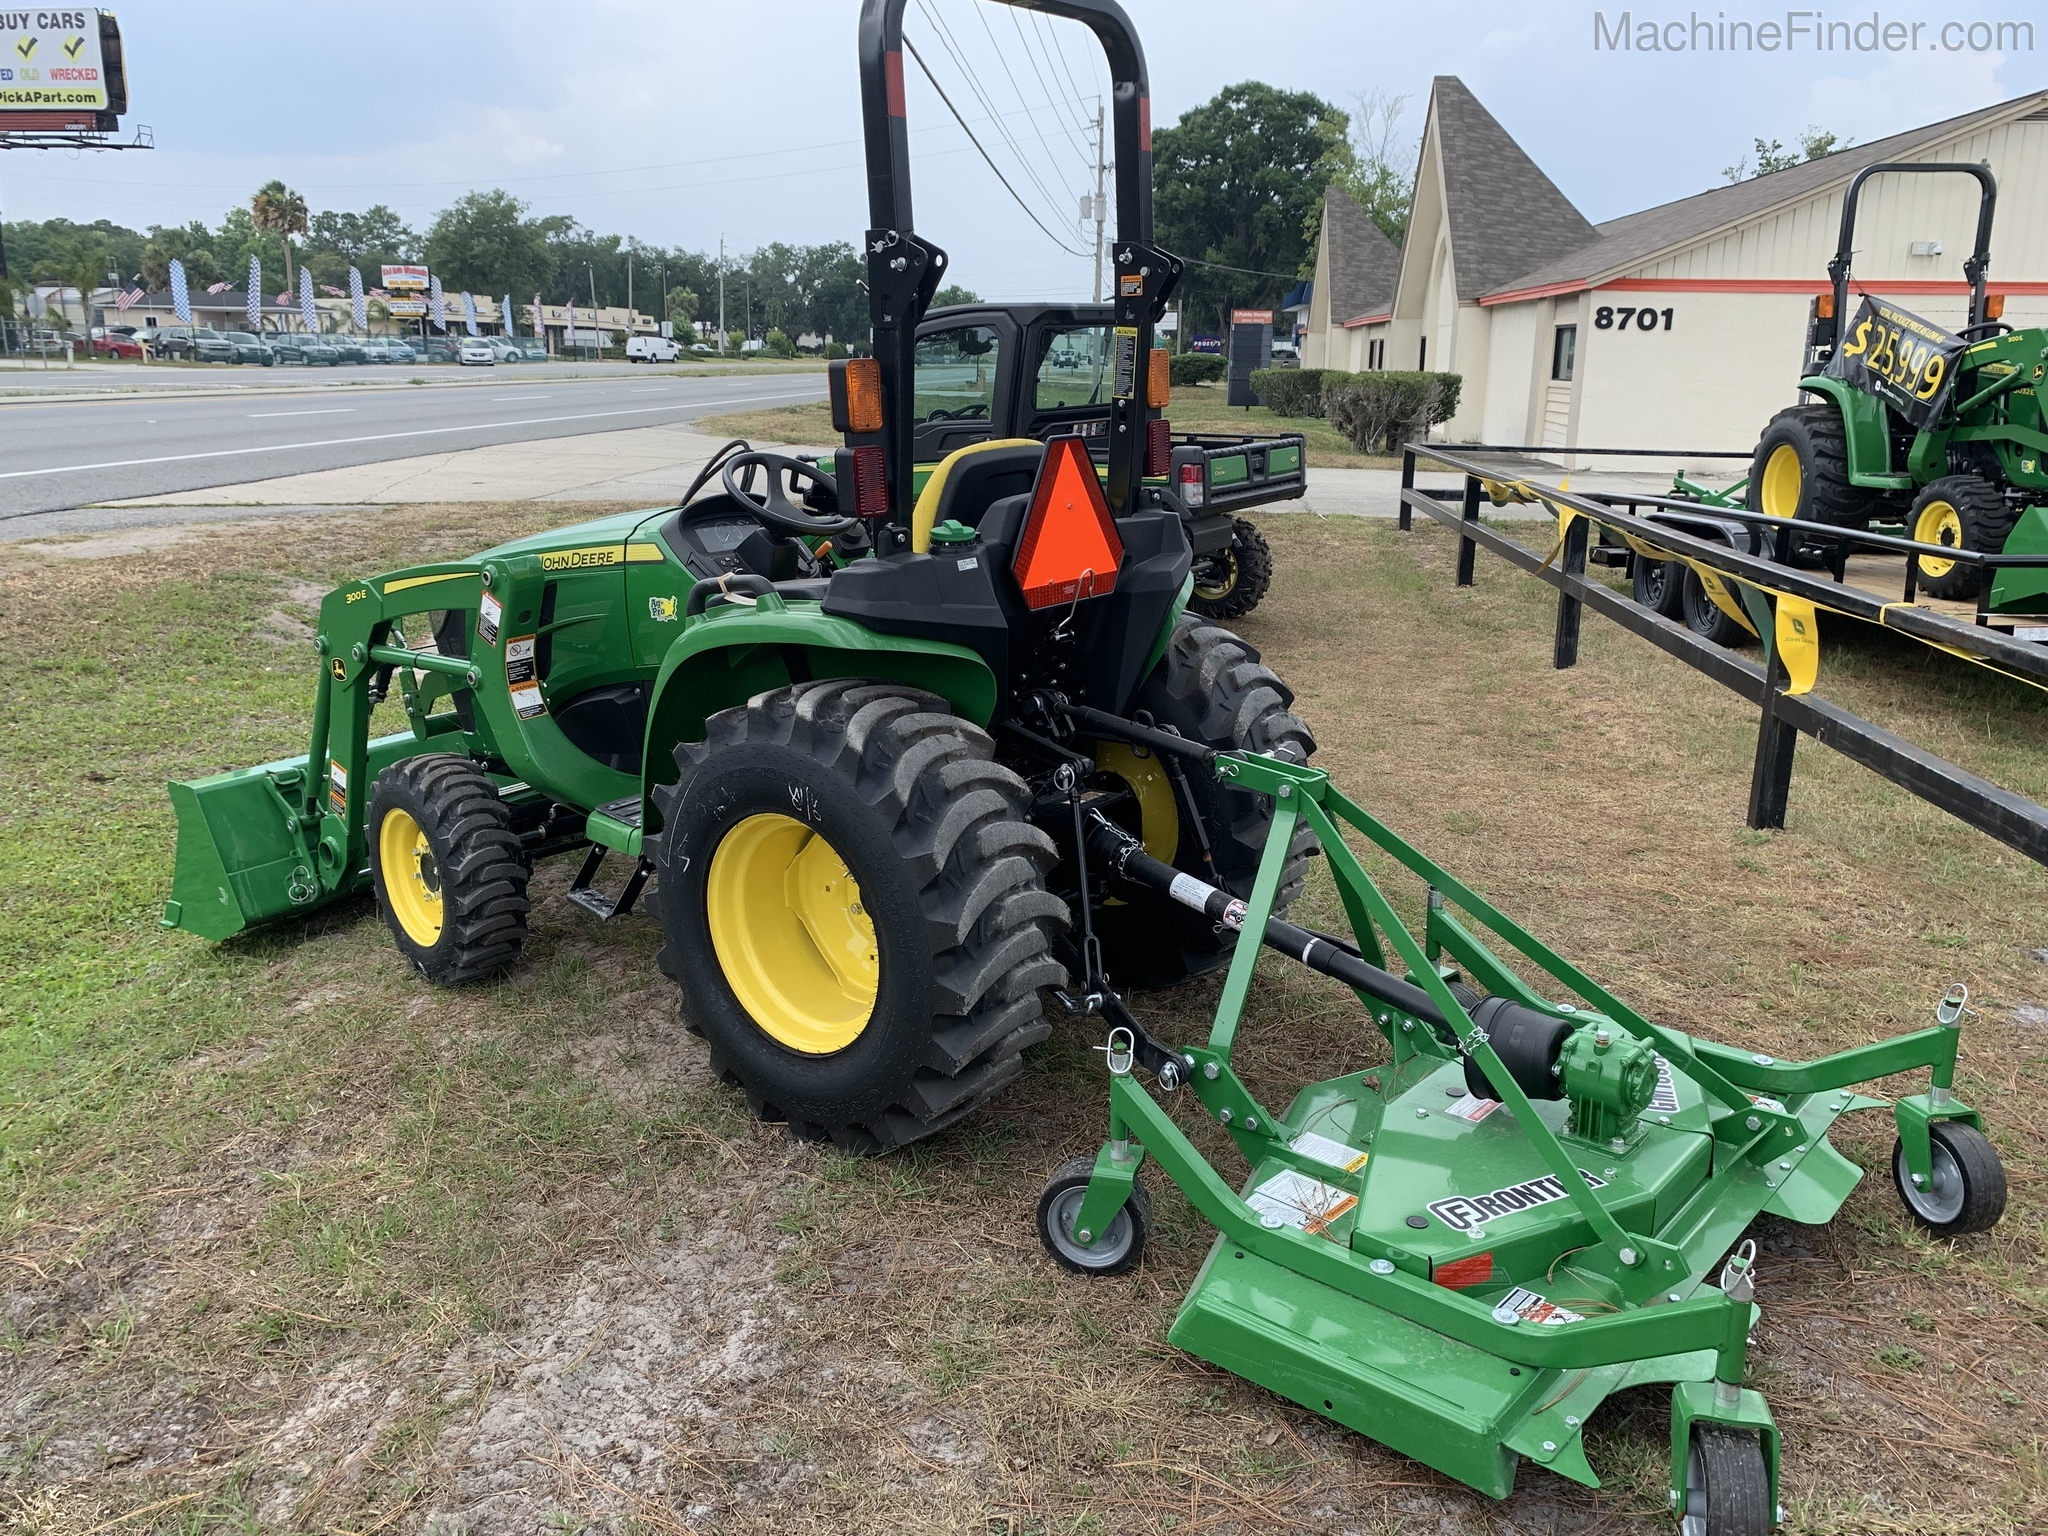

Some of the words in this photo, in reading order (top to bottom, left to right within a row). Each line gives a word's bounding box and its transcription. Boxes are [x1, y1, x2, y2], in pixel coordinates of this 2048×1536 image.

[37, 12, 86, 29] CARS
[20, 68, 39, 81] OLD
[49, 68, 98, 81] WRECKED
[1594, 306, 1673, 331] 8701
[571, 551, 615, 566] DEERE
[653, 608, 665, 616] Pro
[512, 634, 535, 644] WARNING
[514, 682, 538, 692] WARNING
[1429, 1168, 1604, 1229] FRONTIR
